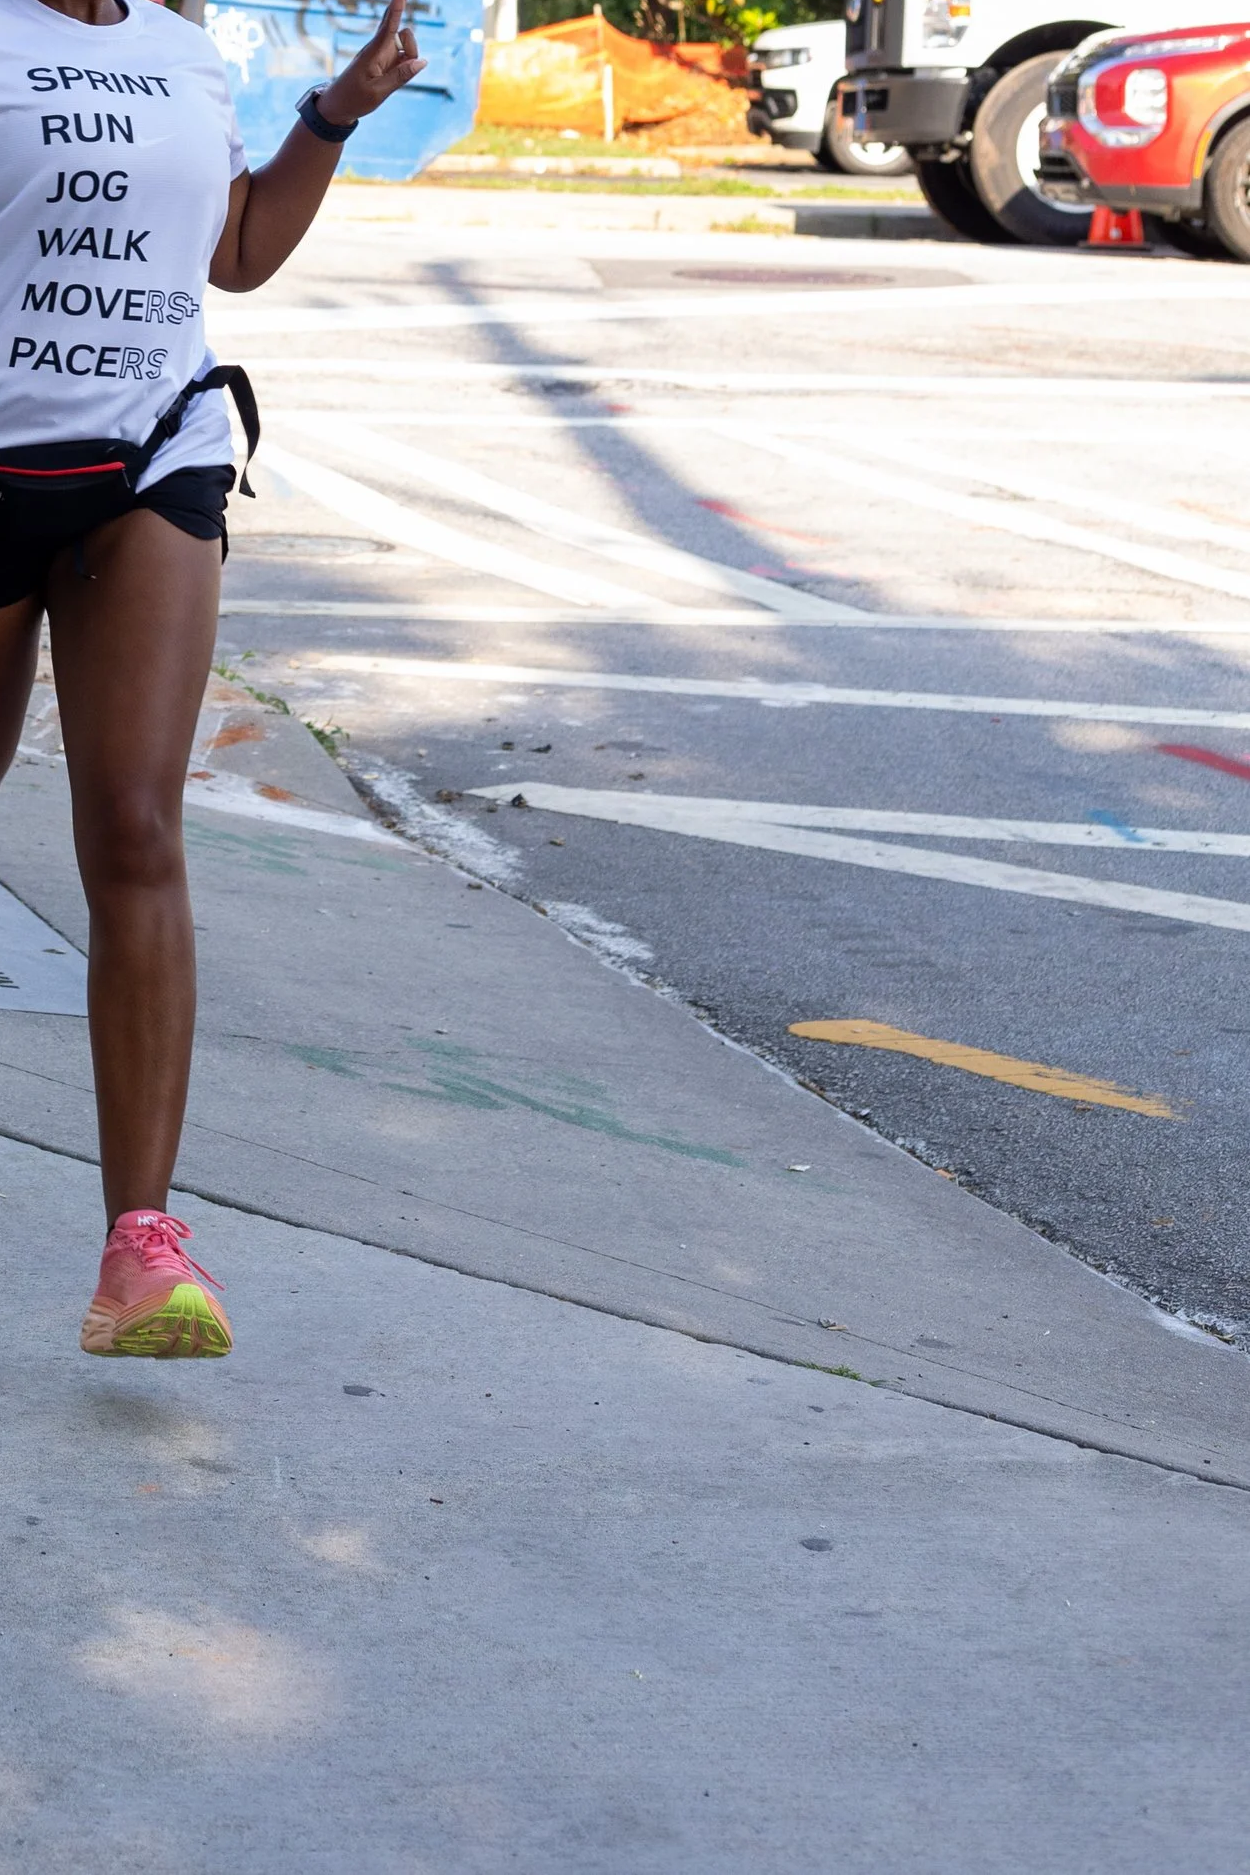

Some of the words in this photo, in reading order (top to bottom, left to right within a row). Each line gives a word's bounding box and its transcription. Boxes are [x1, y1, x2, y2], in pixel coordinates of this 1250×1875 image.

[26, 66, 171, 97] SPRINT
[41, 113, 135, 145] RUN
[46, 170, 129, 203] JOG
[37, 226, 151, 262] WALK
[9, 336, 169, 379] PACERS
